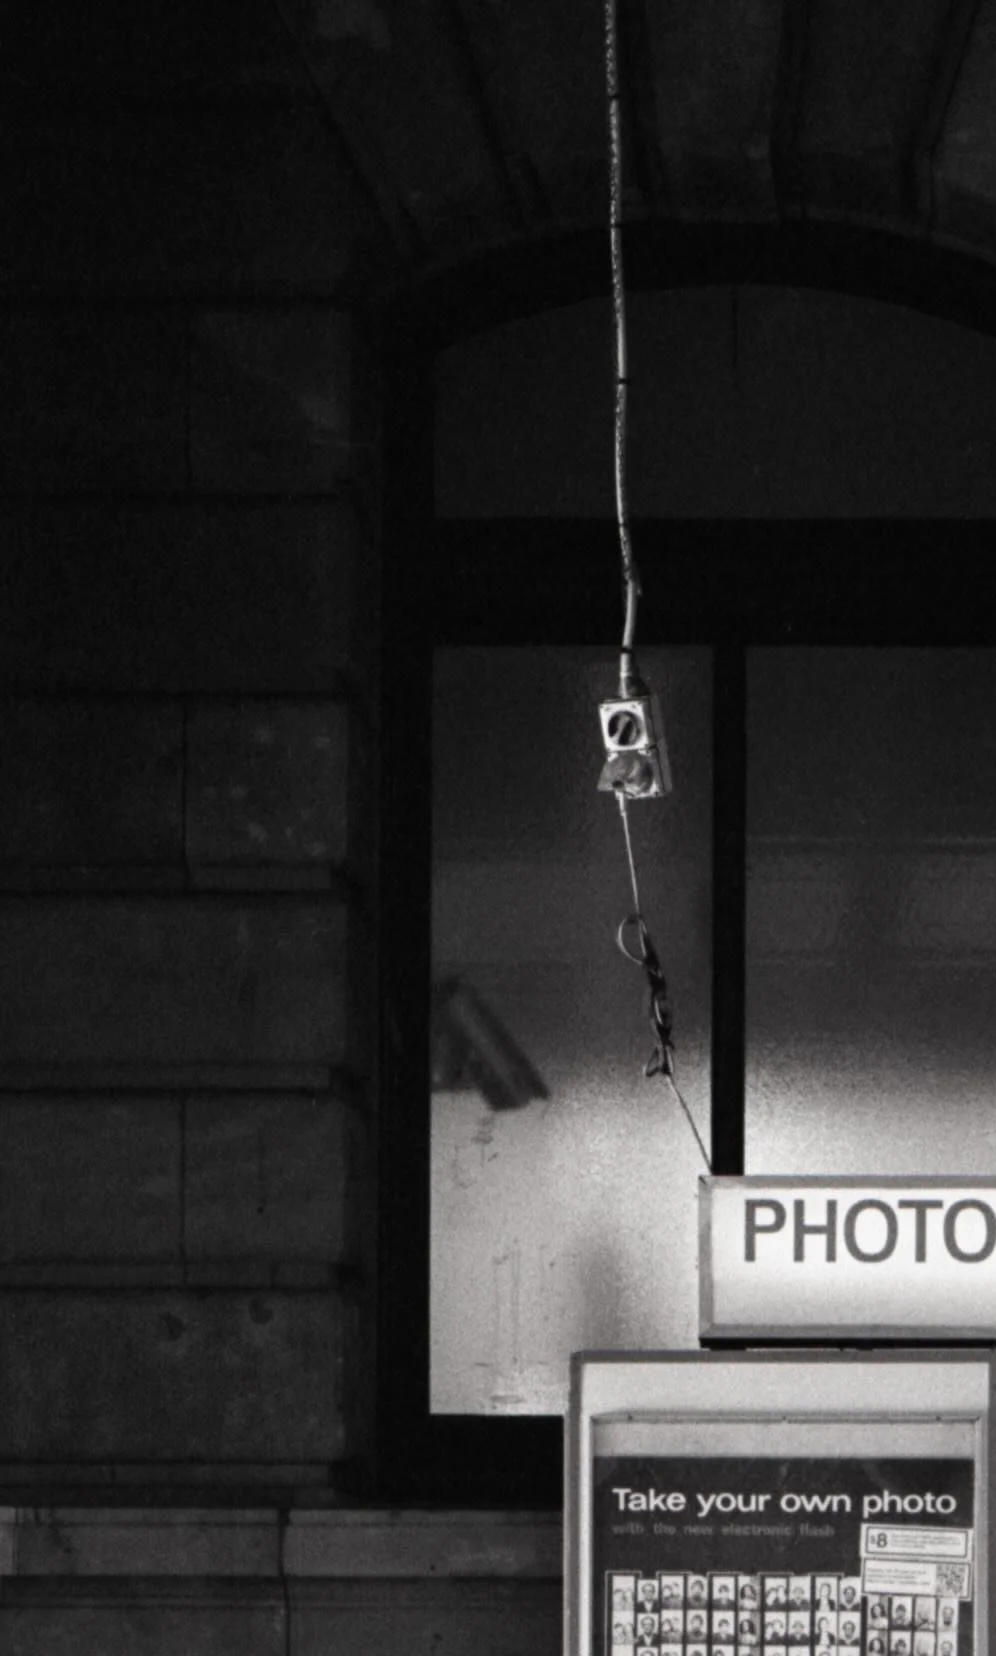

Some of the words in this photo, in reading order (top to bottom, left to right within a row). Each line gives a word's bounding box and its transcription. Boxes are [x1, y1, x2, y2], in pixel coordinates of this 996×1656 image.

[612, 1488, 686, 1512] Take
[697, 1492, 770, 1517] your
[780, 1491, 851, 1513] own
[863, 1490, 957, 1518] photo
[653, 1522, 677, 1535] the
[683, 1525, 714, 1536] new
[721, 1522, 792, 1537] electronic
[800, 1522, 835, 1538] flash
